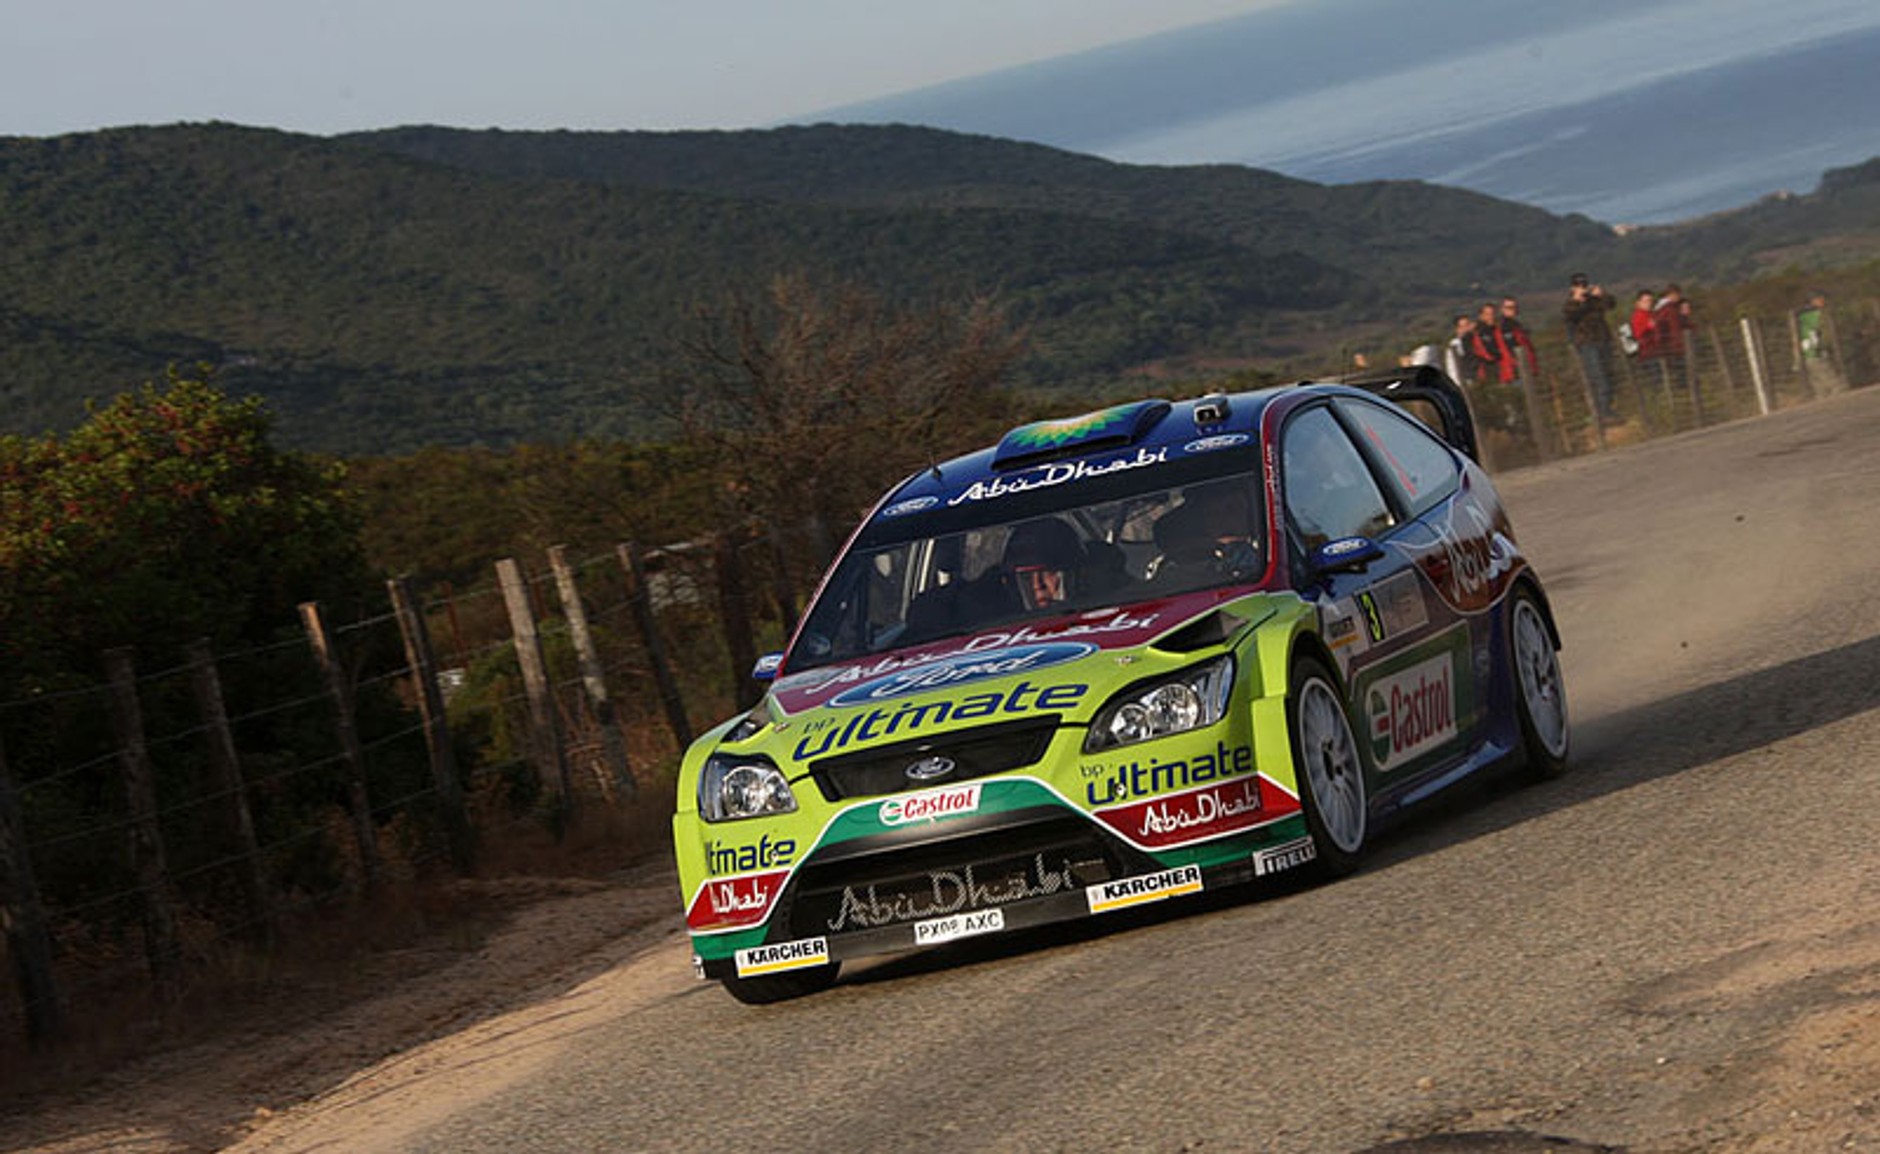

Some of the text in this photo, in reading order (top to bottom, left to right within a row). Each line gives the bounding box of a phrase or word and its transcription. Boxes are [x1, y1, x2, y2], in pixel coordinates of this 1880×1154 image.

[872, 648, 1047, 697] Ford
[792, 681, 1089, 762] ultimate
[1391, 657, 1452, 754] Castrol
[1087, 740, 1252, 806] ultimate
[903, 789, 975, 820] Castrol
[965, 912, 1001, 931] AXC
